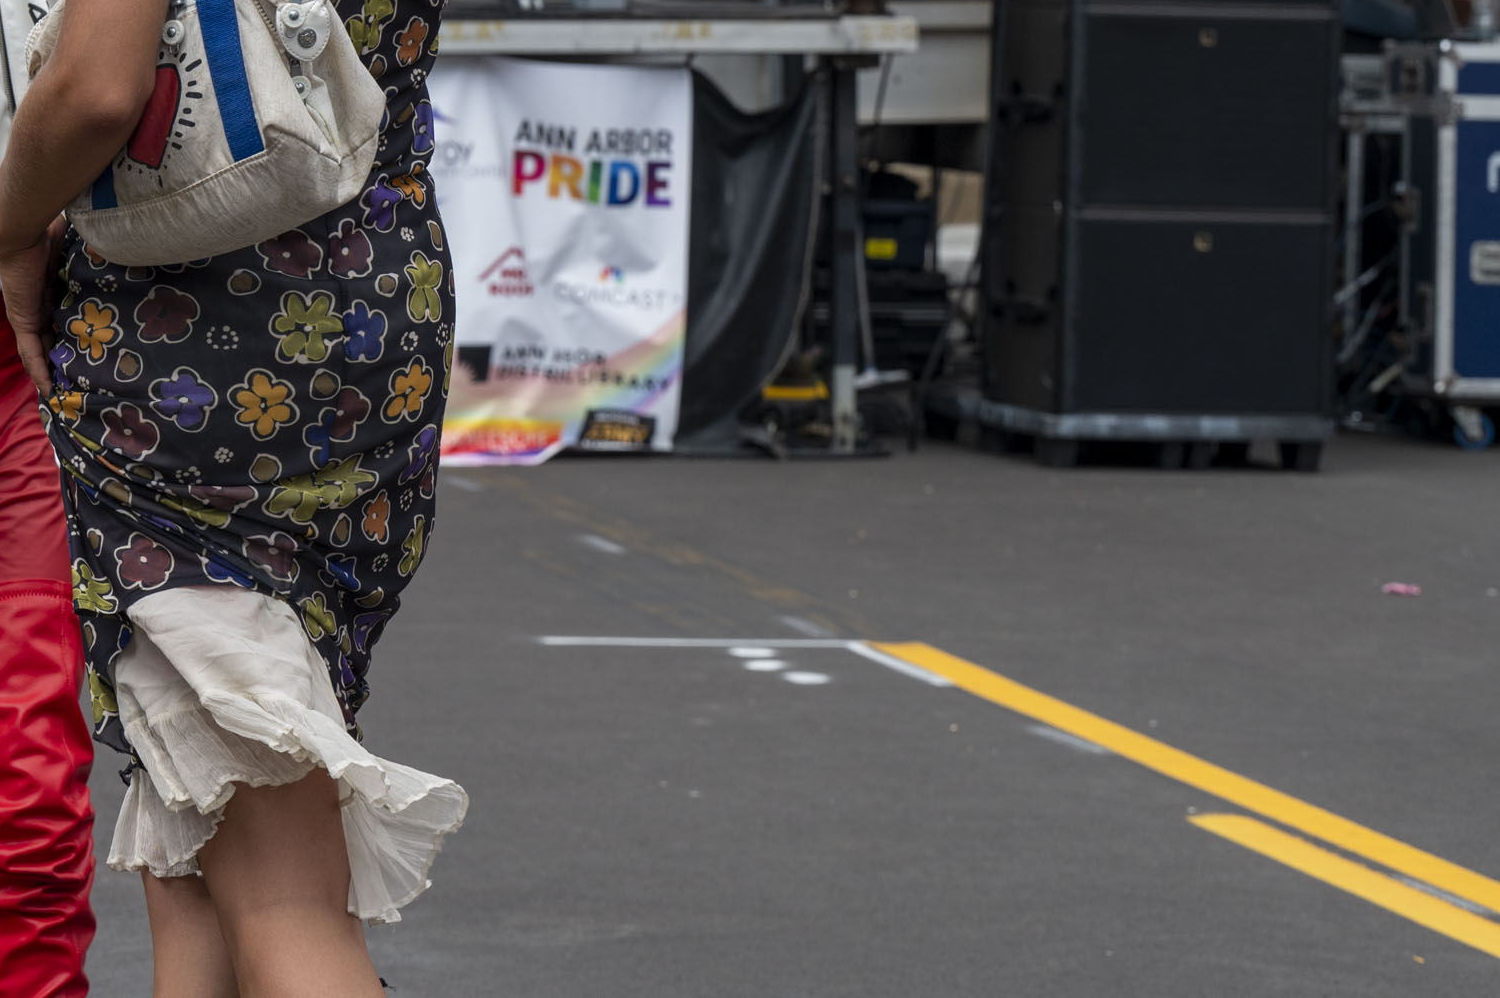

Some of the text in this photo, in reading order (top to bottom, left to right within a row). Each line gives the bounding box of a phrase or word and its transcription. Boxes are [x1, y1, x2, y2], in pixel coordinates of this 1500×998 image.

[514, 119, 673, 157] ANN ARBOR
[512, 150, 673, 209] PRIDE
